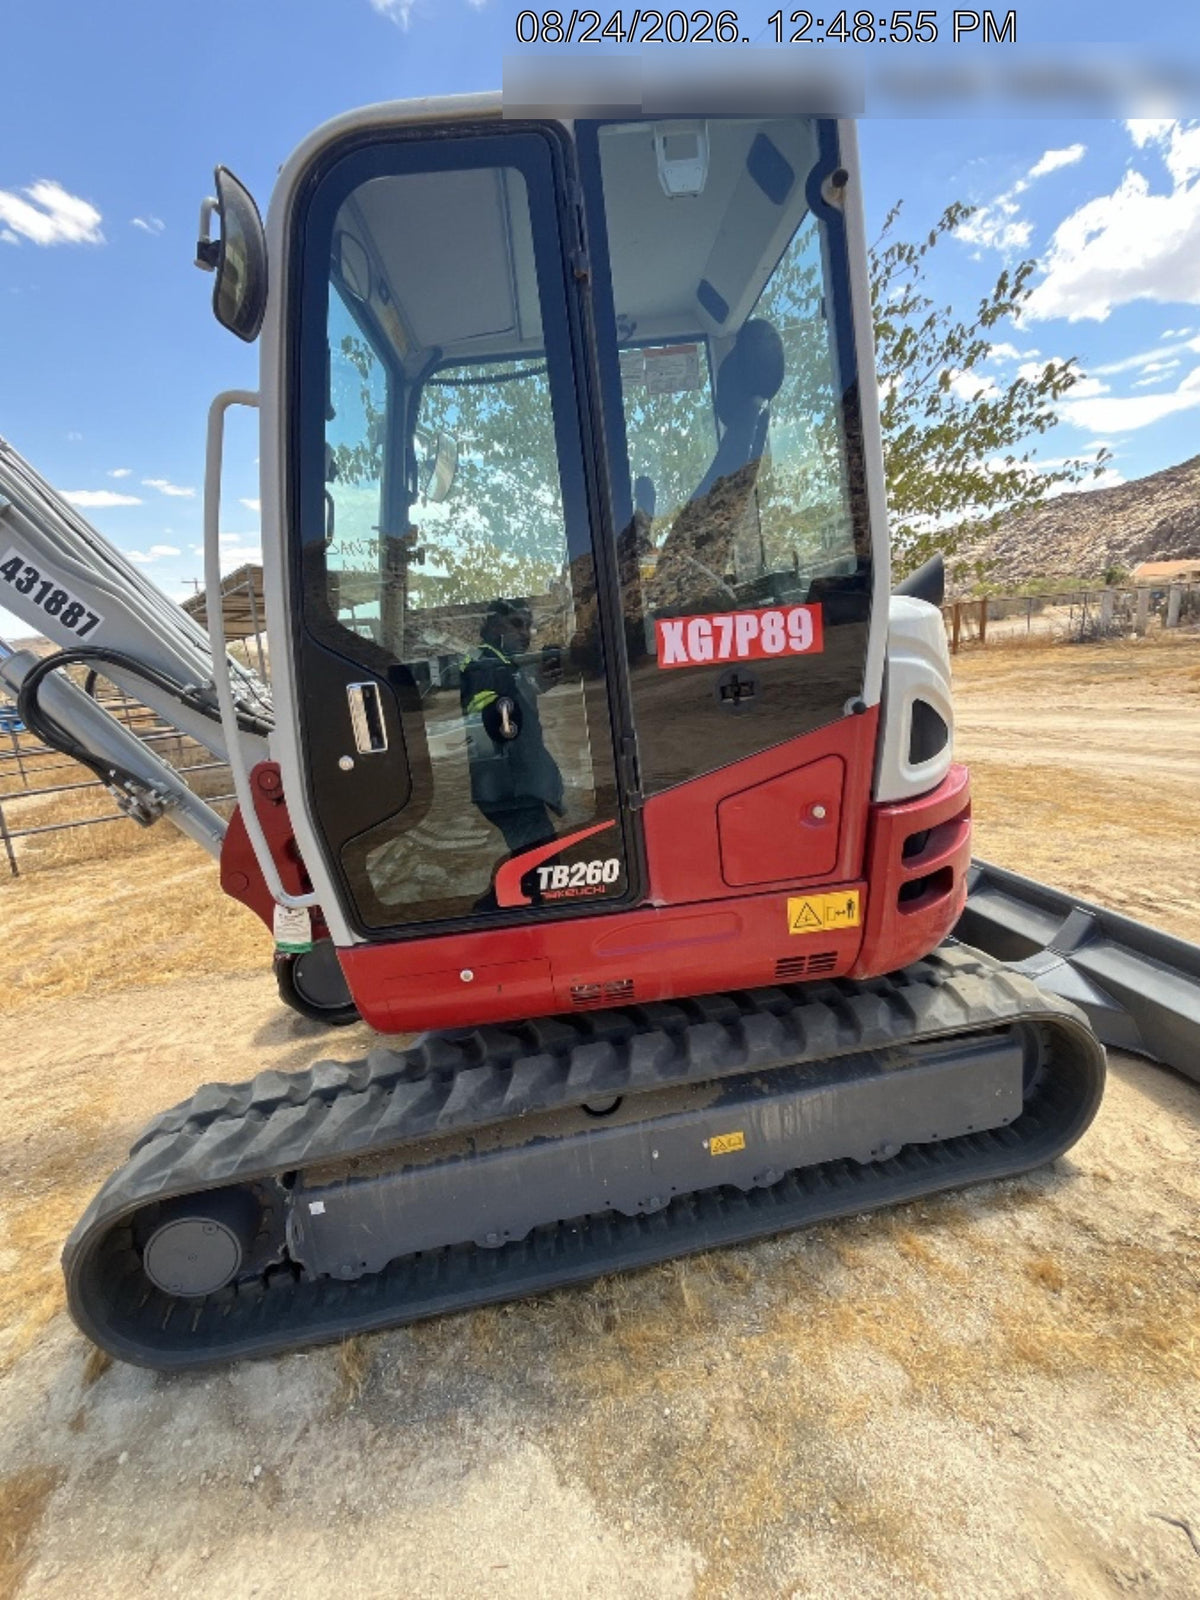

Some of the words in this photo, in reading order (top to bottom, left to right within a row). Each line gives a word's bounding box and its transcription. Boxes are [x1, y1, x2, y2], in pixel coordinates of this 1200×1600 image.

[0, 556, 101, 637] 431887
[660, 607, 813, 665] XG7P89
[536, 858, 620, 890] TB260
